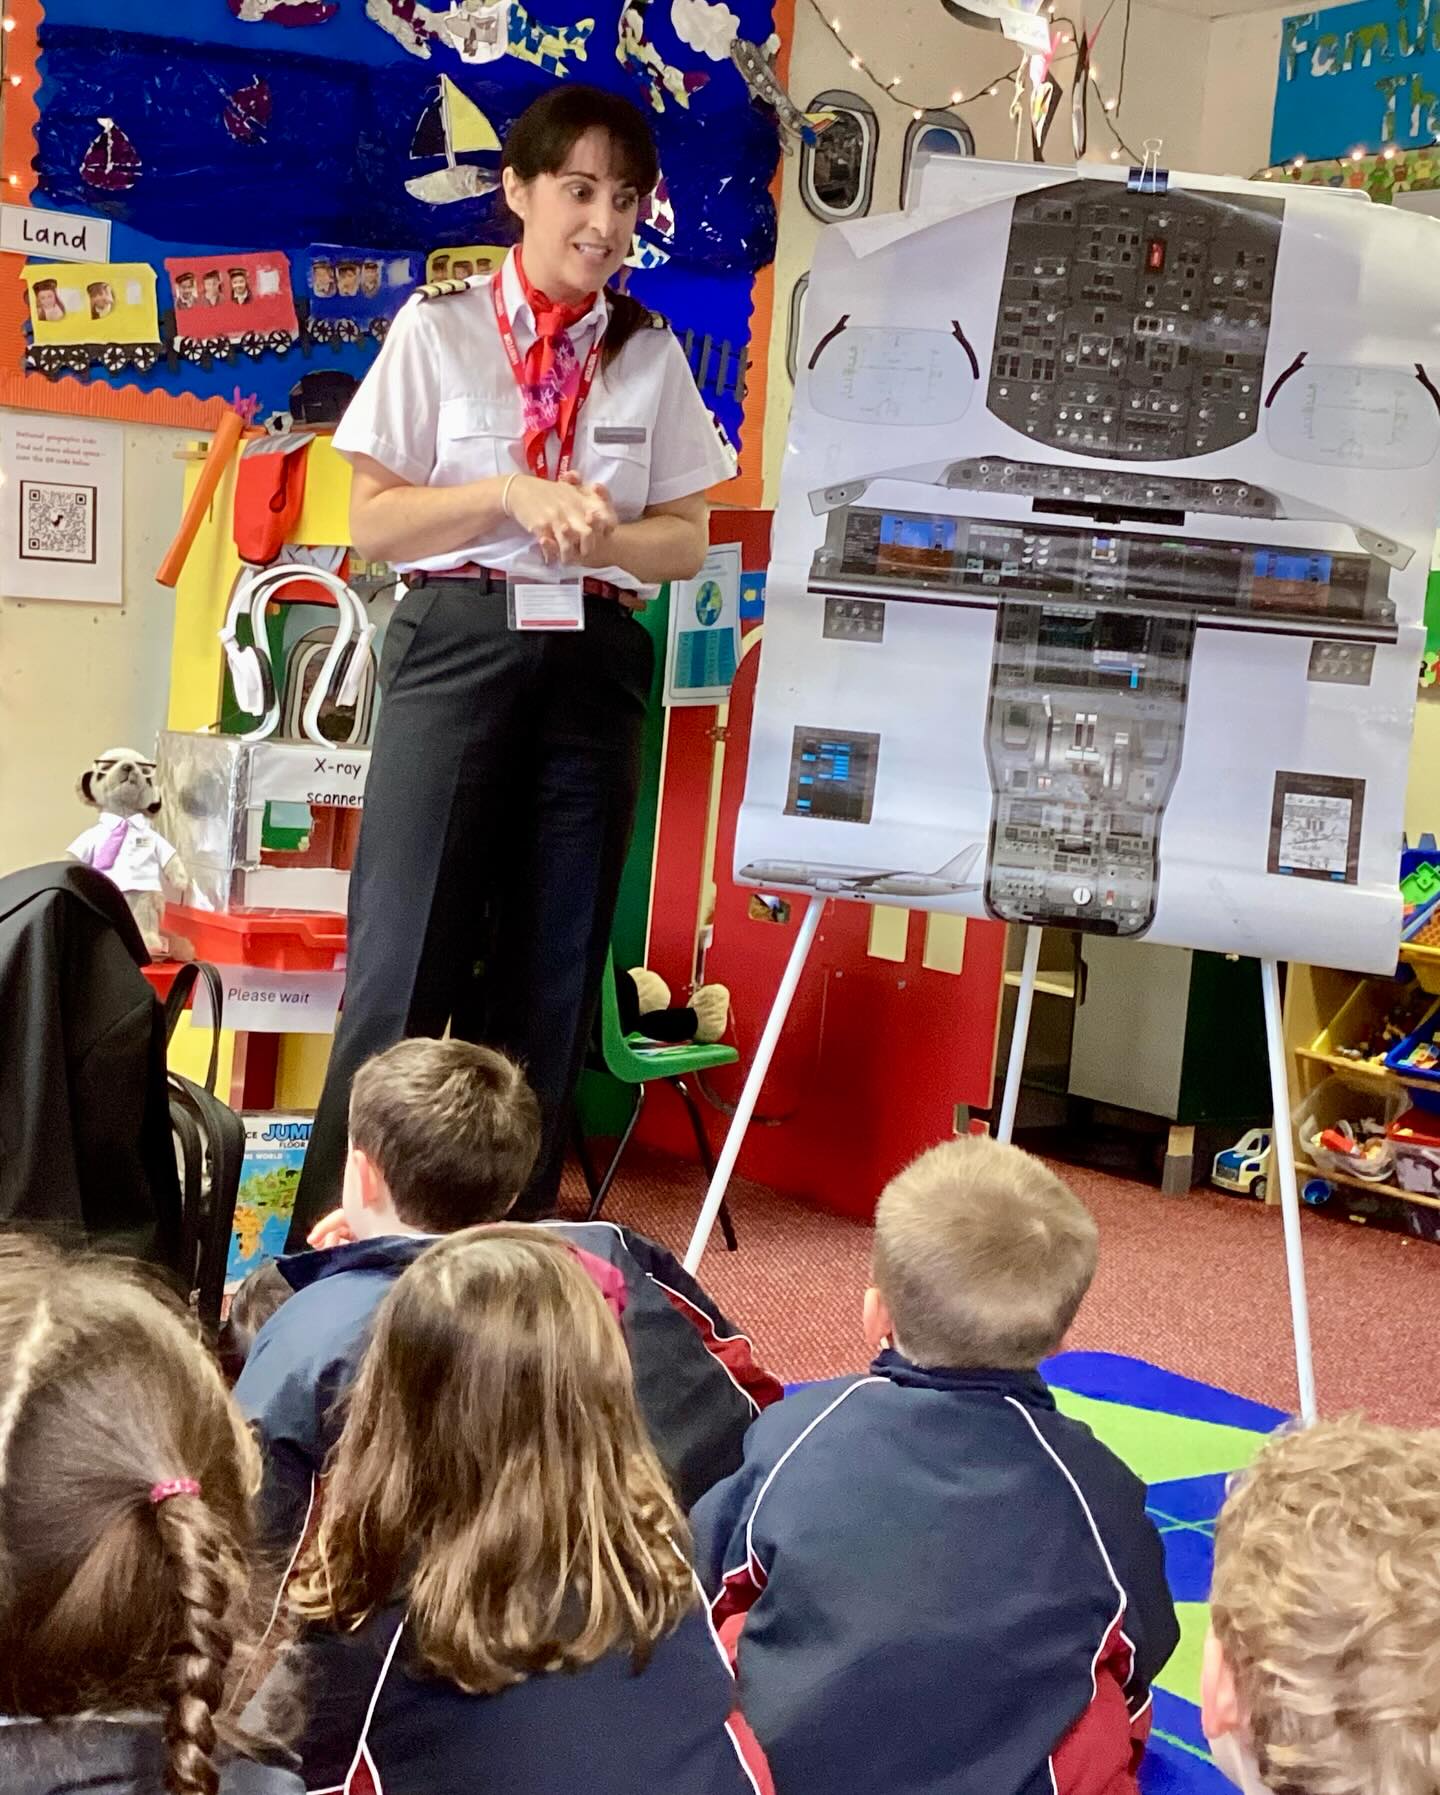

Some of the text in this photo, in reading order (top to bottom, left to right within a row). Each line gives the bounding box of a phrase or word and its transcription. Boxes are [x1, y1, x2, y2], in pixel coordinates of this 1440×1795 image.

[23, 219, 86, 251] Land
[314, 758, 361, 780] X-ray
[228, 988, 310, 1004] Please wait
